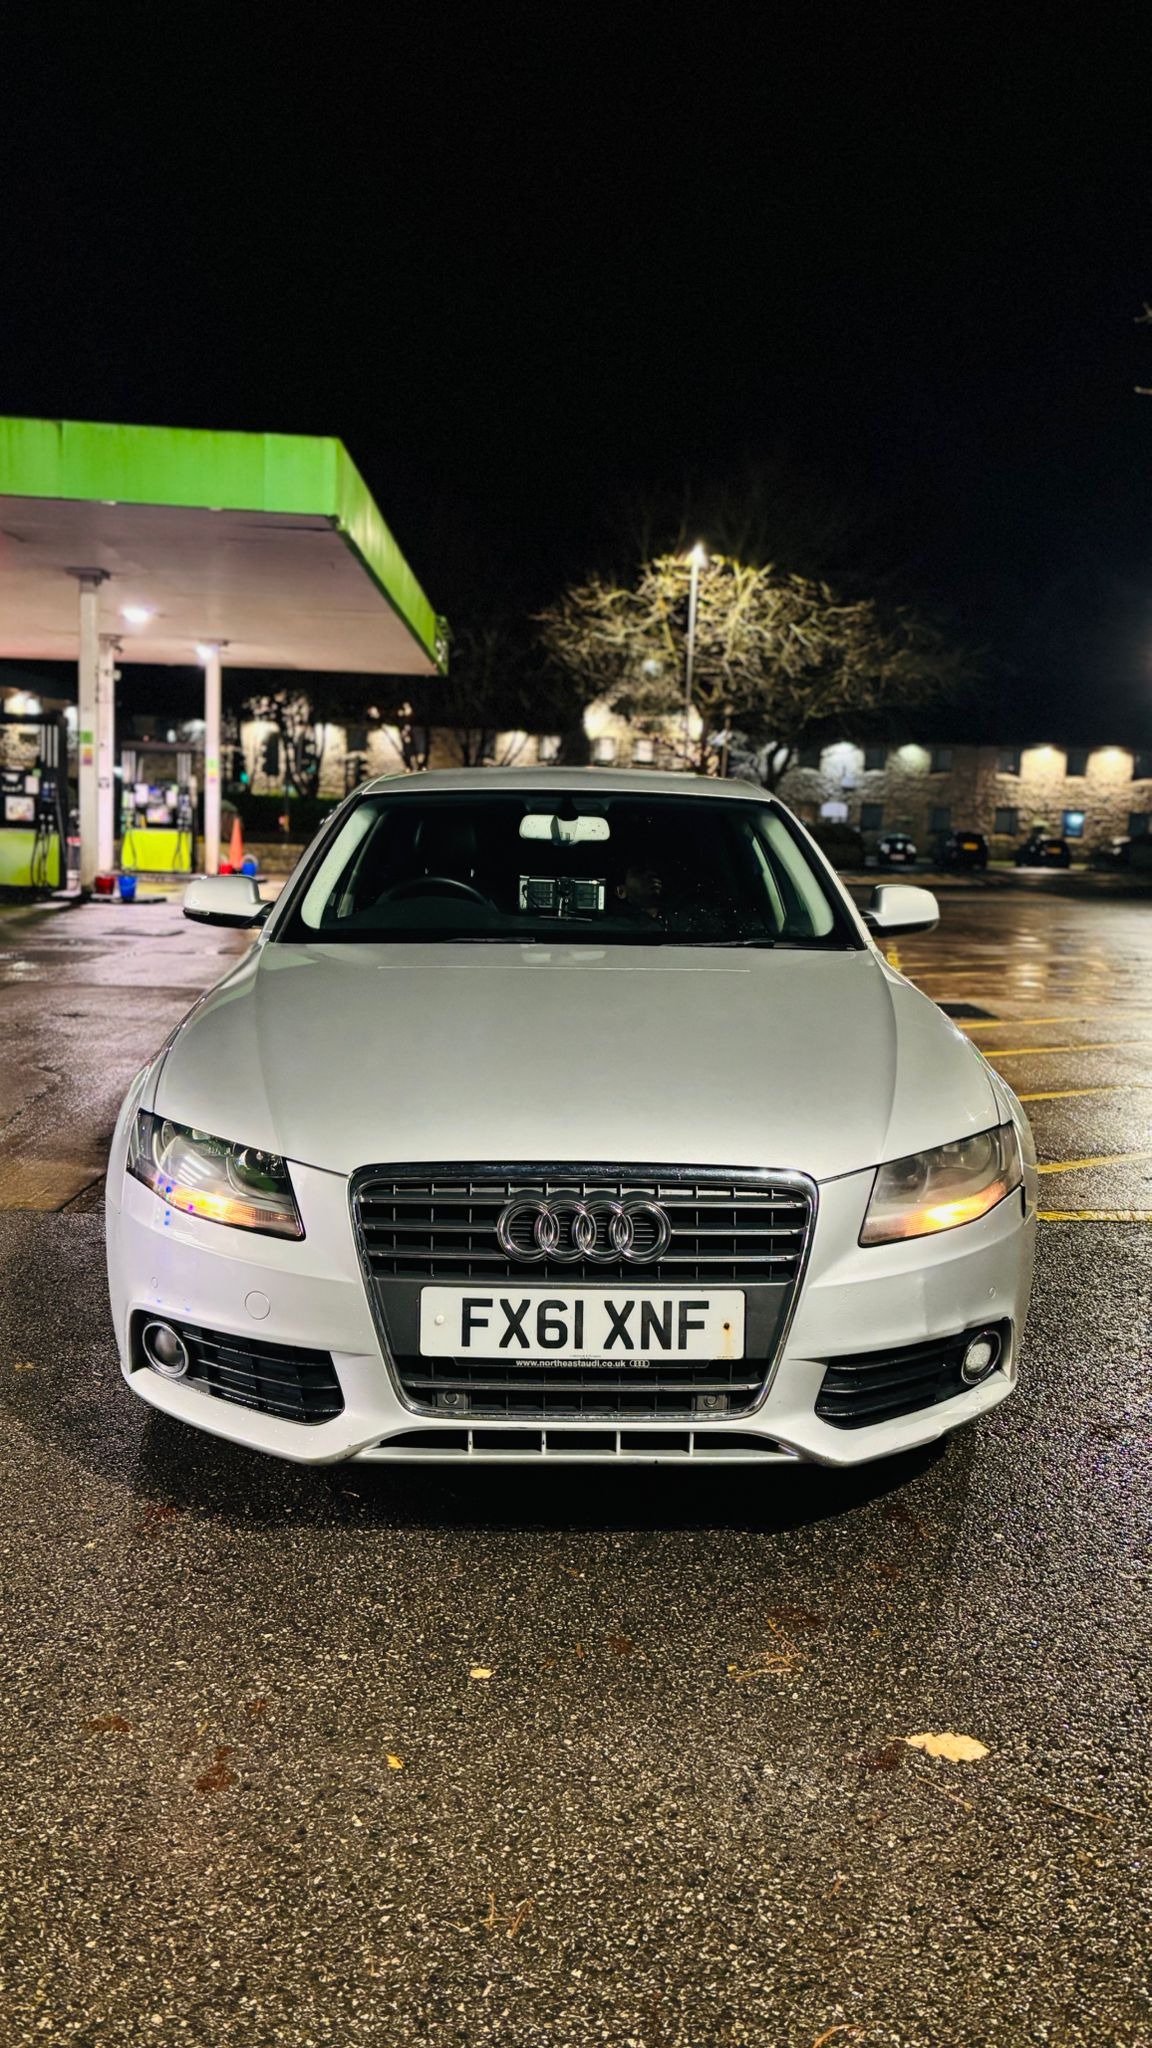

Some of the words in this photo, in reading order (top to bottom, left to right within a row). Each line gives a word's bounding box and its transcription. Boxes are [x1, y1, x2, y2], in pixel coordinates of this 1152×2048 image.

[461, 1298, 584, 1349] FX61
[603, 1300, 710, 1350] XNF
[515, 1359, 626, 1368] www.northeastaudi.co.uk
